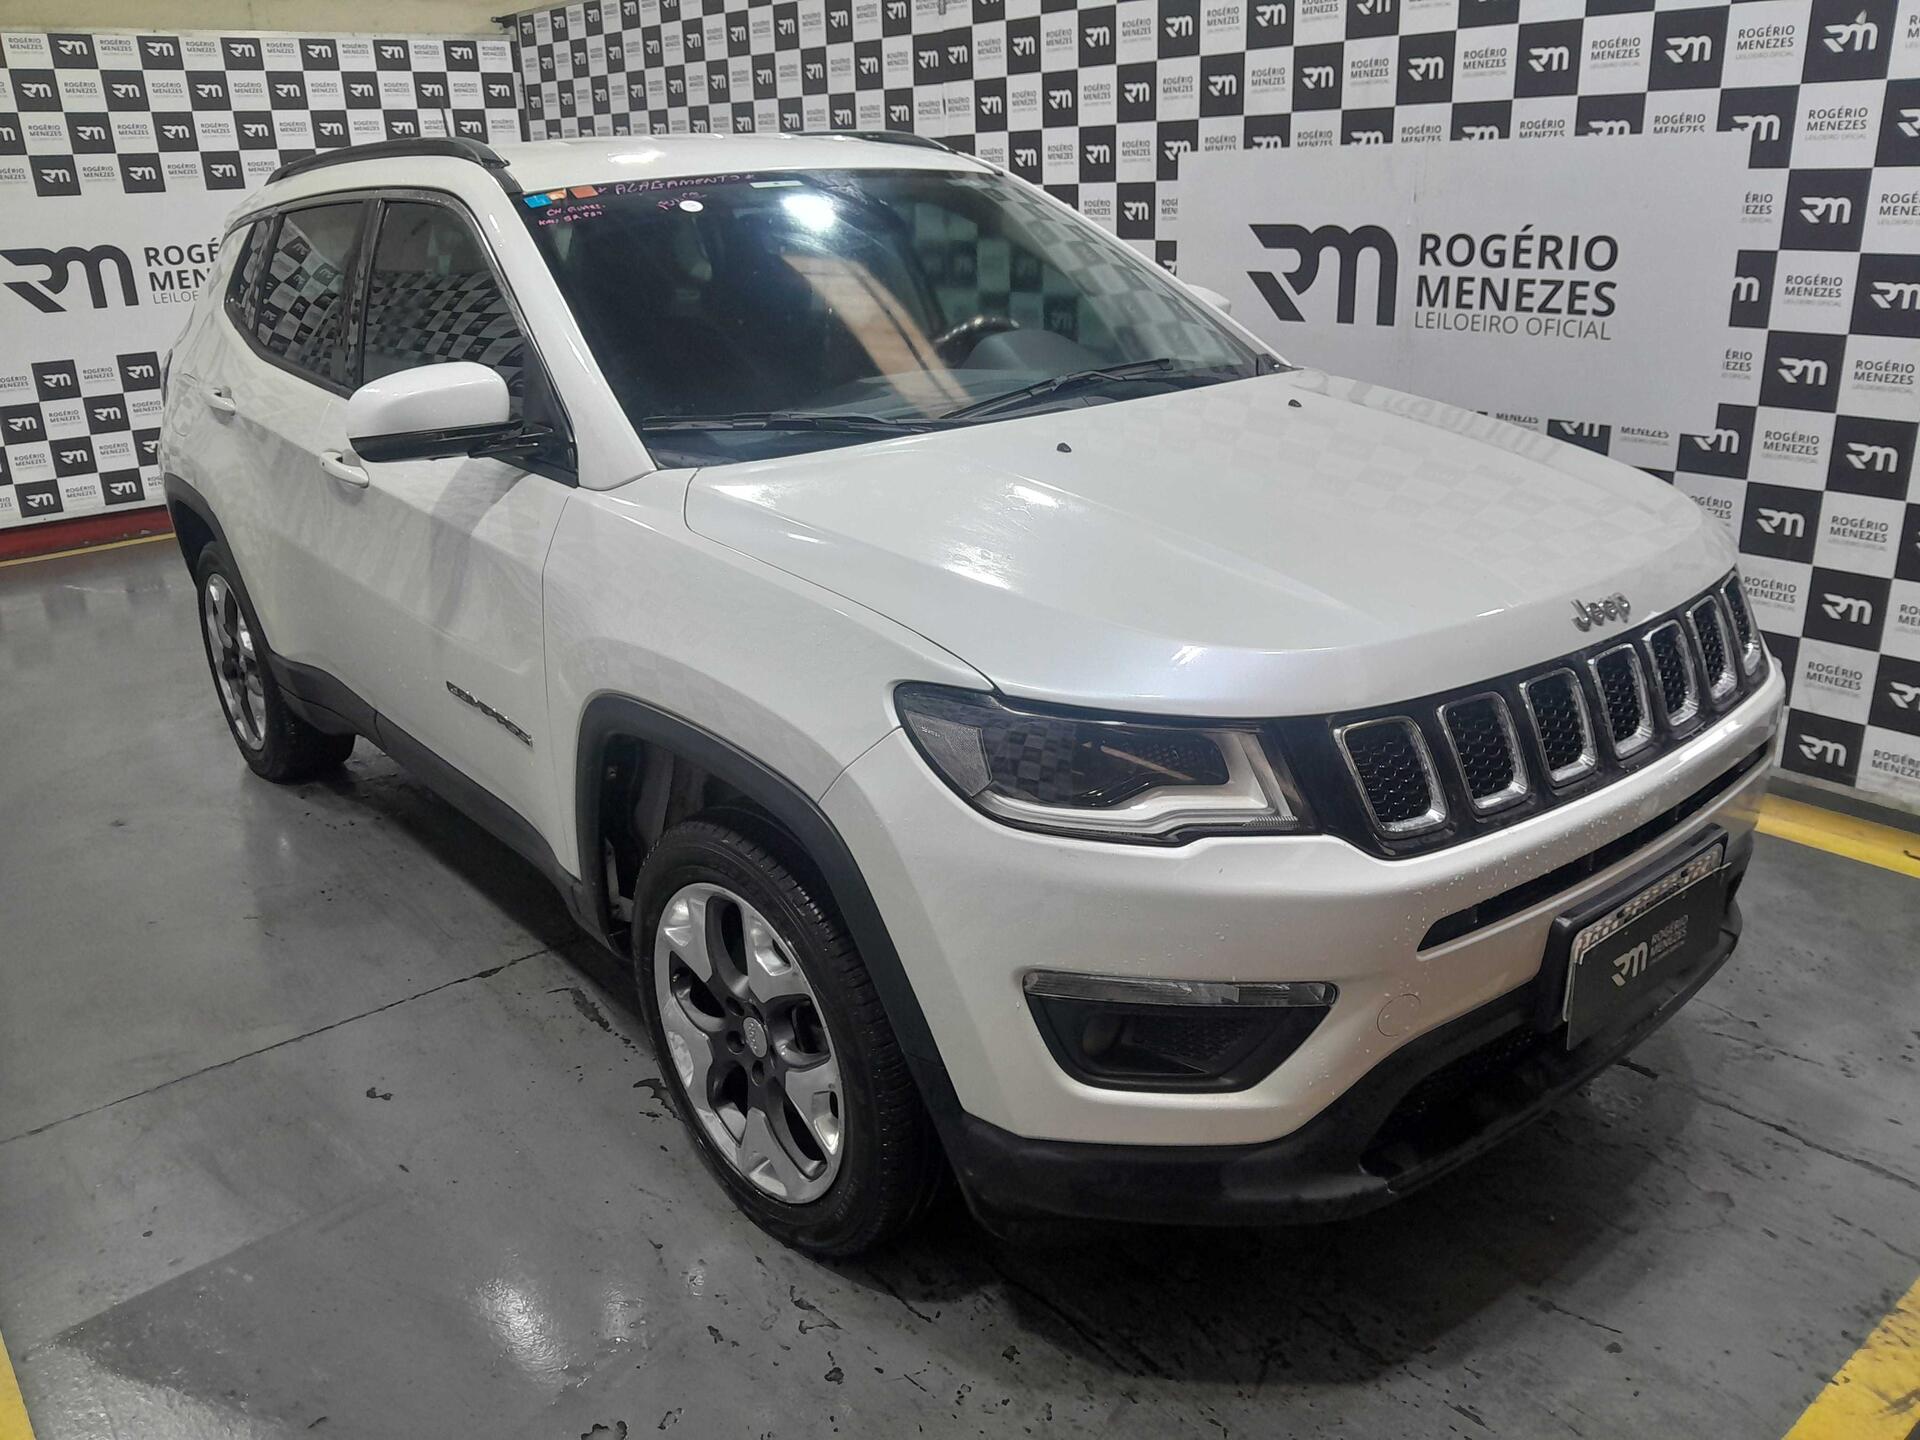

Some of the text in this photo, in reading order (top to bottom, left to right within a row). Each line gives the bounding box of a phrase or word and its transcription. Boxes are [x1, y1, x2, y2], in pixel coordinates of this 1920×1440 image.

[1207, 16, 1240, 27] MENEZES
[1738, 25, 1795, 39] ROGÉRIO
[1591, 36, 1641, 50] ROGÉRIO
[1737, 37, 1794, 50] MENEZES
[1464, 48, 1507, 60] ROGÉRIO
[1590, 47, 1640, 61] MENEZES
[1351, 58, 1389, 69] ROGÉRIO
[1463, 58, 1506, 70] MENEZES
[1351, 67, 1389, 79] MENEZES
[1251, 76, 1286, 87] MENEZES
[1654, 113, 1706, 125] ROGÉRIO
[1808, 106, 1868, 120] ROGÉRIO
[1401, 124, 1442, 136] ROGÉRIO
[1520, 119, 1565, 131] ROGÉRIO
[1806, 118, 1867, 132] MENEZES
[1881, 190, 1920, 204] ROGÉ
[1879, 205, 1920, 216] MENE
[1418, 224, 1619, 272] ROGÉRIO
[1785, 274, 1843, 288] ROGÉRIO
[1415, 275, 1618, 317] MENEZES
[1784, 286, 1842, 298] MENEZES
[1414, 310, 1612, 341] LEILOEIRO OFICIAL
[1855, 359, 1916, 374] ROGÉRIO
[1853, 371, 1915, 386] MENEZES
[1764, 430, 1820, 445] ROGÉRIO
[1762, 441, 1819, 456] MENEZES
[1831, 515, 1889, 533] ROGÉRIO
[1829, 525, 1888, 543] MENEZES
[1745, 586, 1796, 604] MENEZES
[1570, 592, 1631, 632] Jeep
[1807, 661, 1864, 681] ROGÉRIO
[1805, 670, 1862, 692] MENEZES
